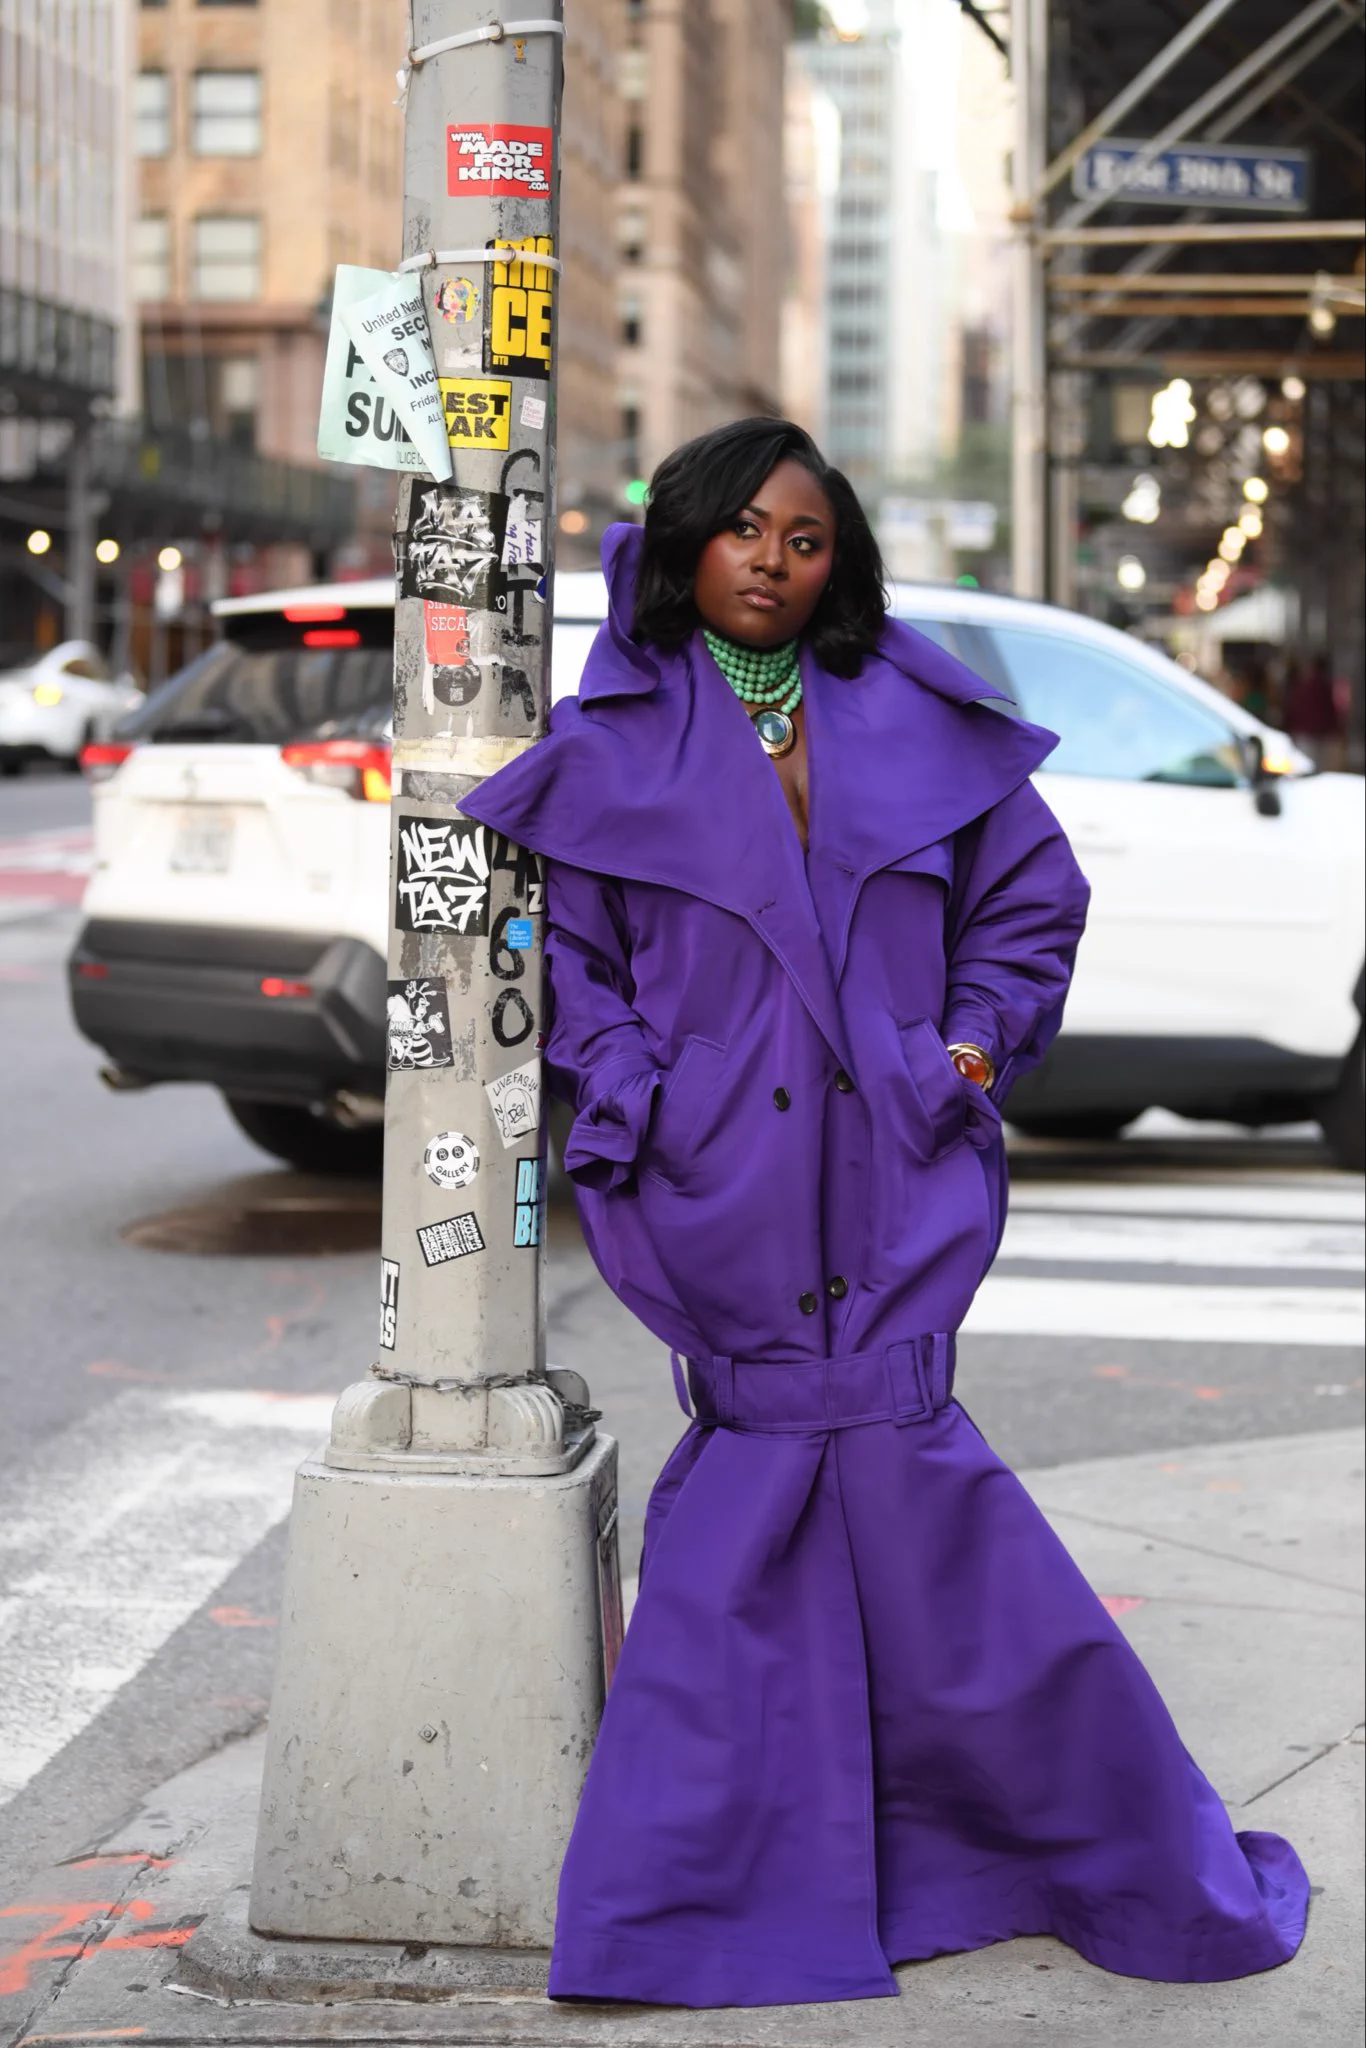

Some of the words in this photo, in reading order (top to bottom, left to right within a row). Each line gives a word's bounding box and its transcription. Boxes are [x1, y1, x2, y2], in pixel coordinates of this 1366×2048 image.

[459, 140, 543, 156] MADE
[474, 153, 532, 168] FOR
[458, 167, 545, 182] KINGS
[362, 305, 401, 333] United
[441, 391, 509, 416] EST
[446, 415, 497, 439] AK
[397, 451, 417, 464] LICE
[400, 821, 490, 883] NEW
[435, 1161, 470, 1178] GALLERY
